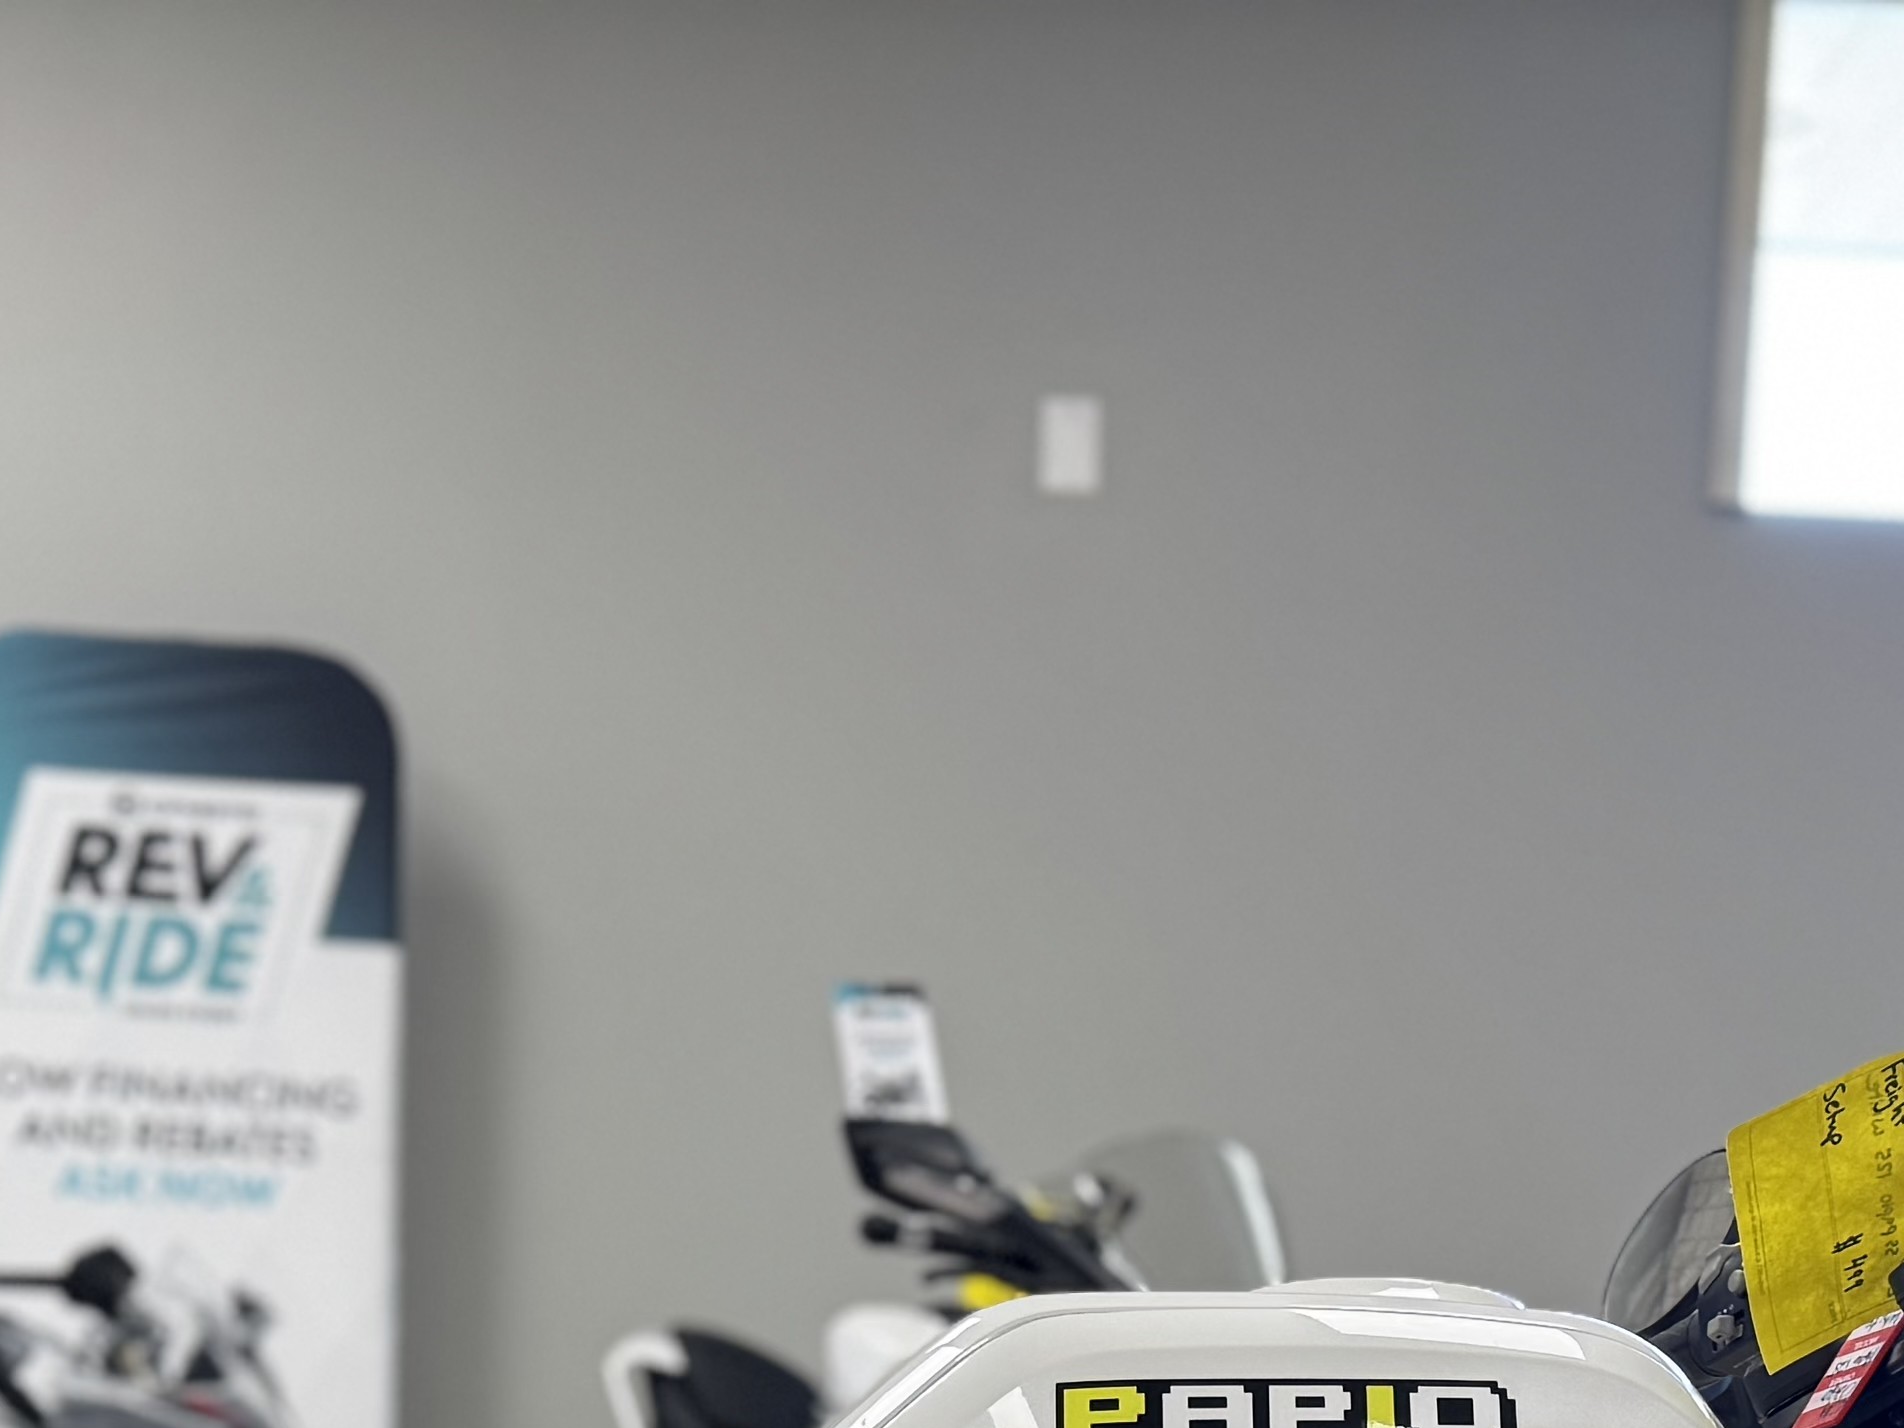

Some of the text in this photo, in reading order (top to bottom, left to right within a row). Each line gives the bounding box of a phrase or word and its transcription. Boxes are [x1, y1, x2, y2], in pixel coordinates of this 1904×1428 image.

[56, 821, 260, 905] REV
[30, 911, 263, 999] RIDE
[14, 1108, 119, 1152] AND
[1820, 1082, 1847, 1147] Setup
[1842, 1251, 1865, 1293] 499
